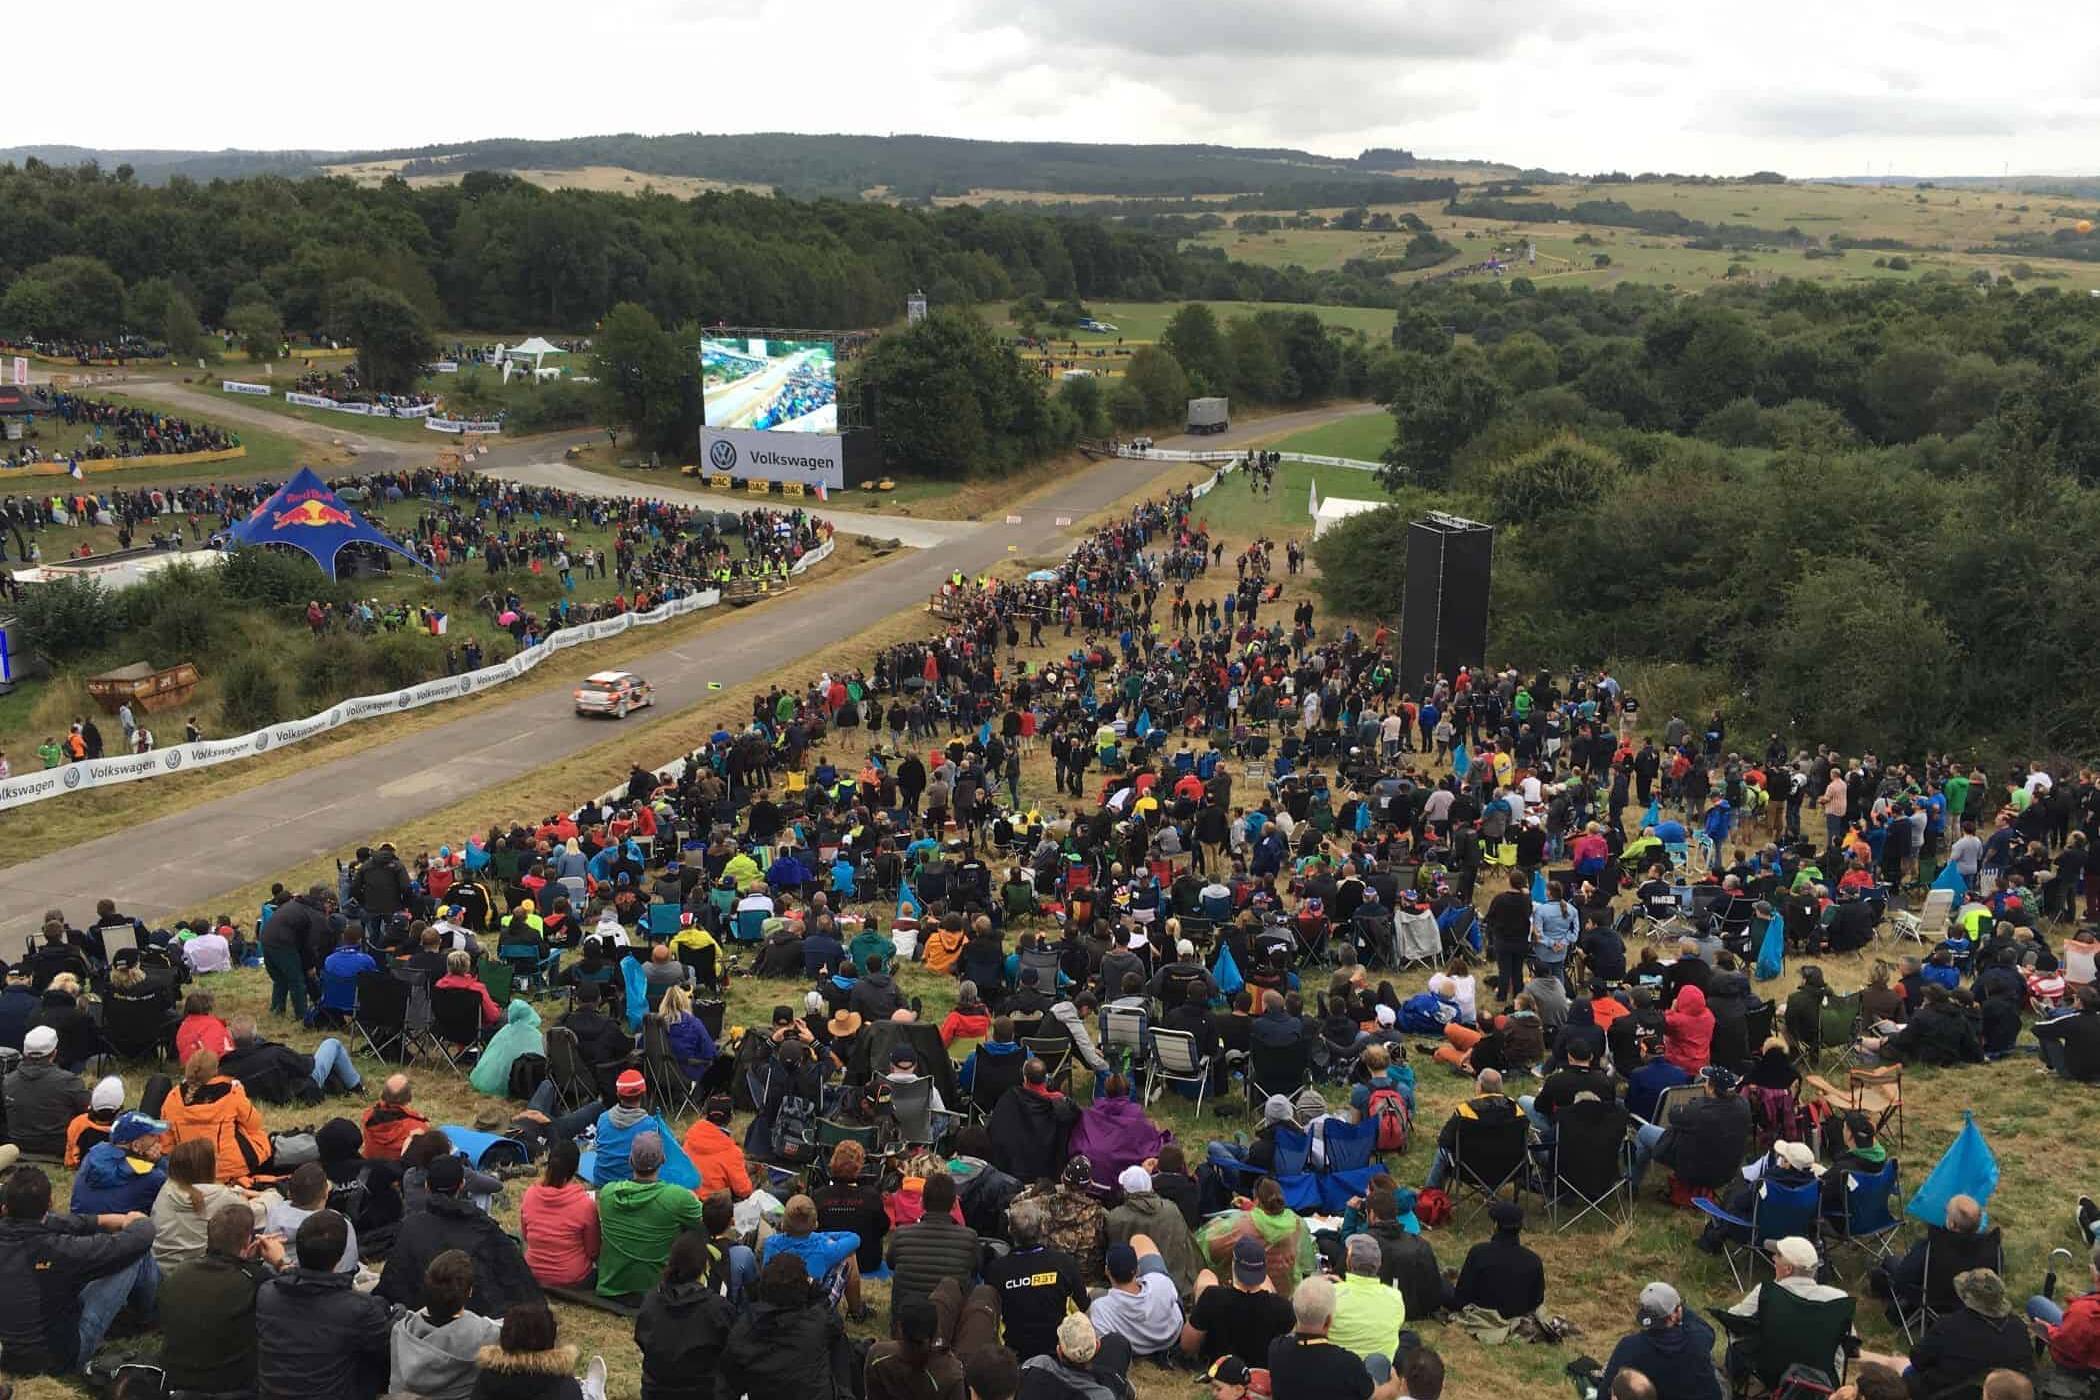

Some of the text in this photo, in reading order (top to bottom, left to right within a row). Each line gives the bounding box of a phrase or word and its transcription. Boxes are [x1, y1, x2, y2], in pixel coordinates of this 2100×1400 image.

[750, 451, 834, 471] Volkswagen
[345, 700, 393, 718] Volkswagen
[191, 742, 249, 761] Volkswagen
[90, 759, 156, 780] Volkswagen
[0, 779, 55, 800] lkswagen
[1005, 1277, 1031, 1289] CLIO
